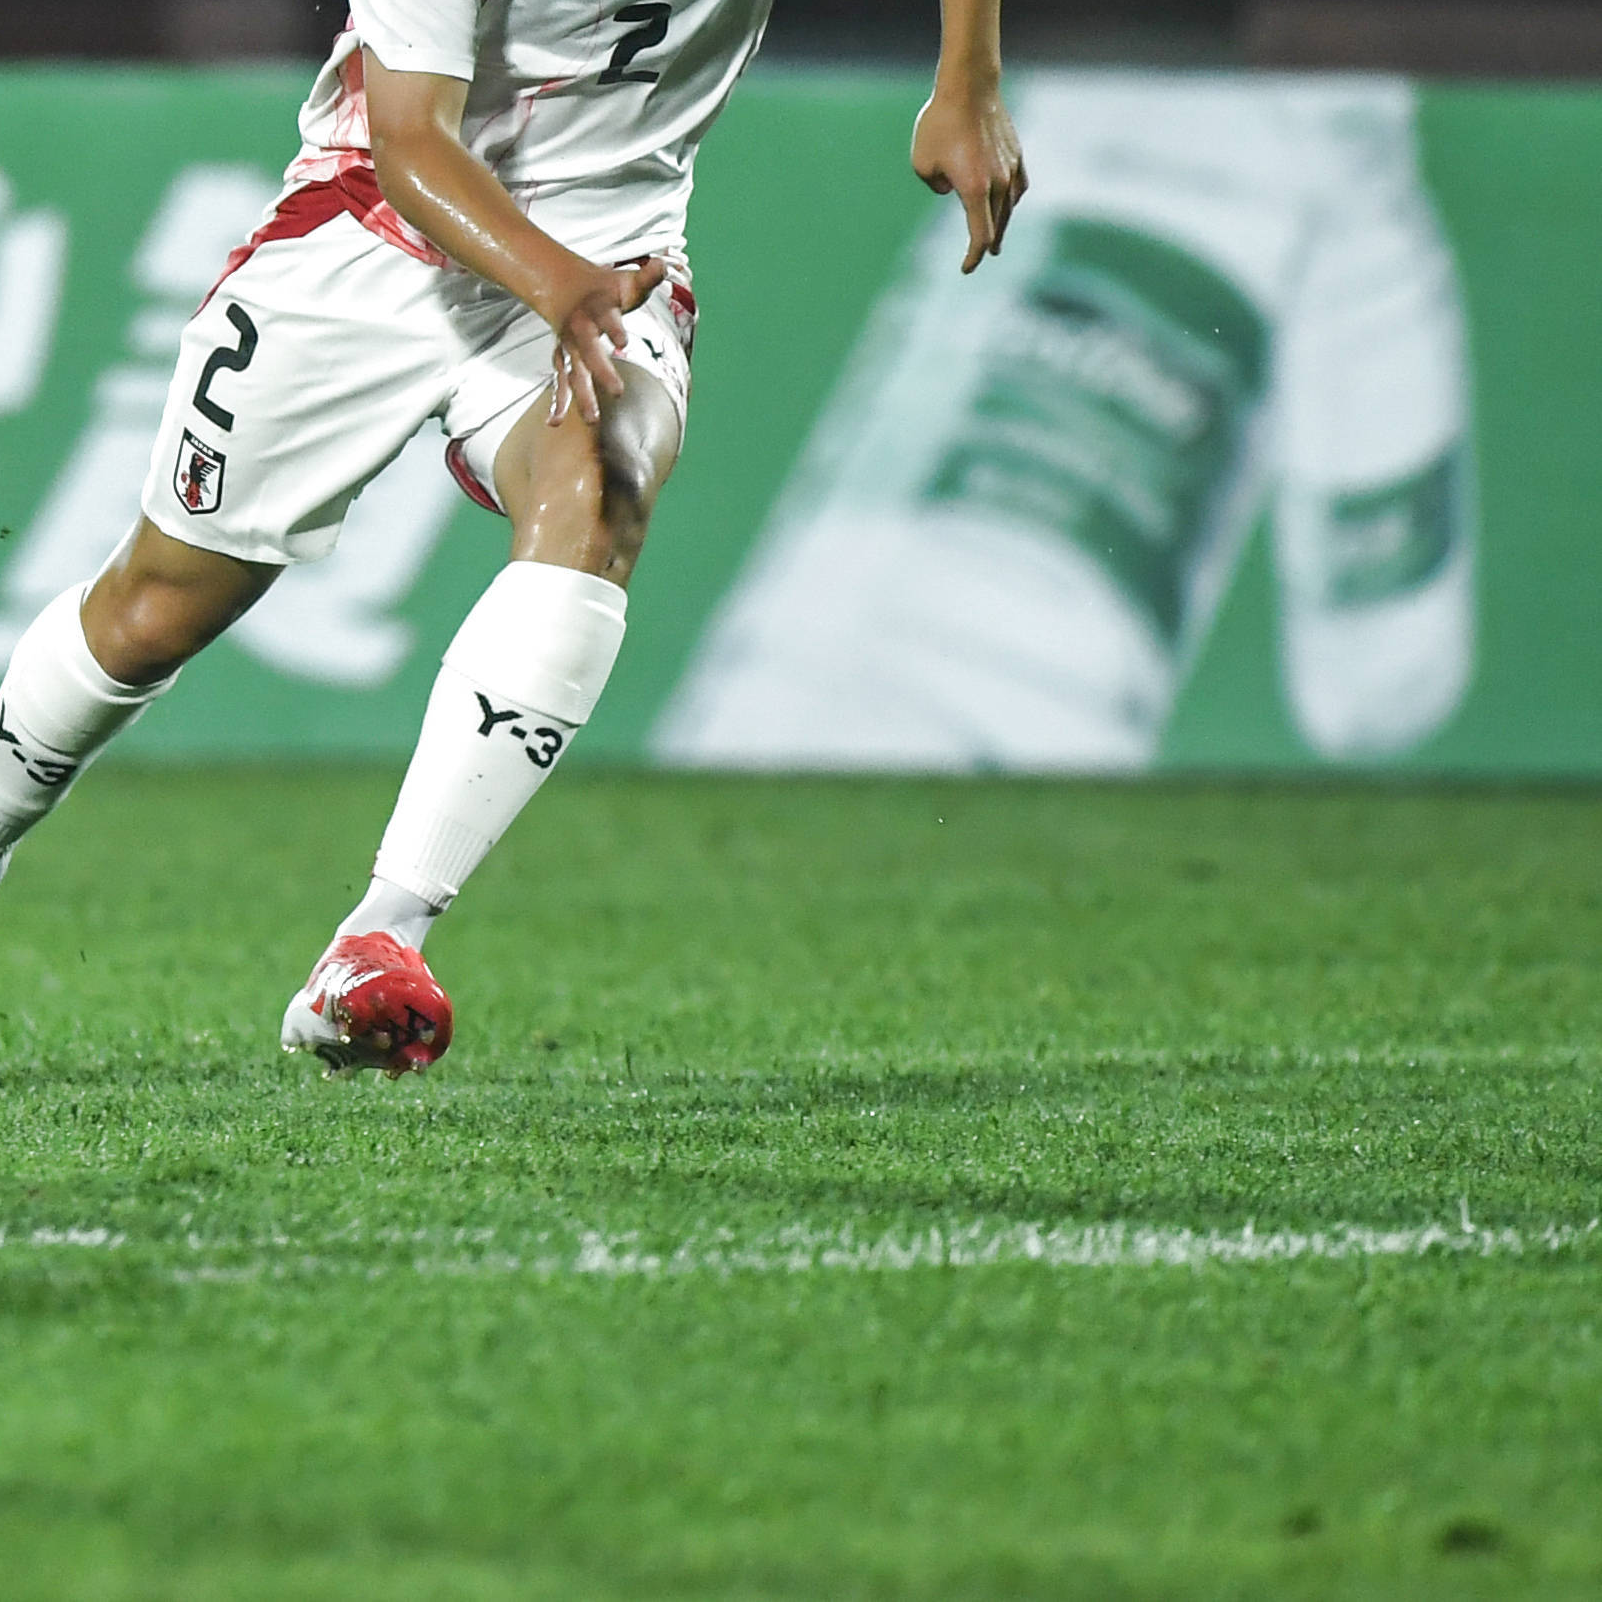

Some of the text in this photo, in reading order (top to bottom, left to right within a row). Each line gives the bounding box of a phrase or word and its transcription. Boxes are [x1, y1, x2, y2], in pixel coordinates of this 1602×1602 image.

[597, 2, 672, 85] 2
[192, 302, 259, 433] 2
[473, 690, 564, 770] Y-3
